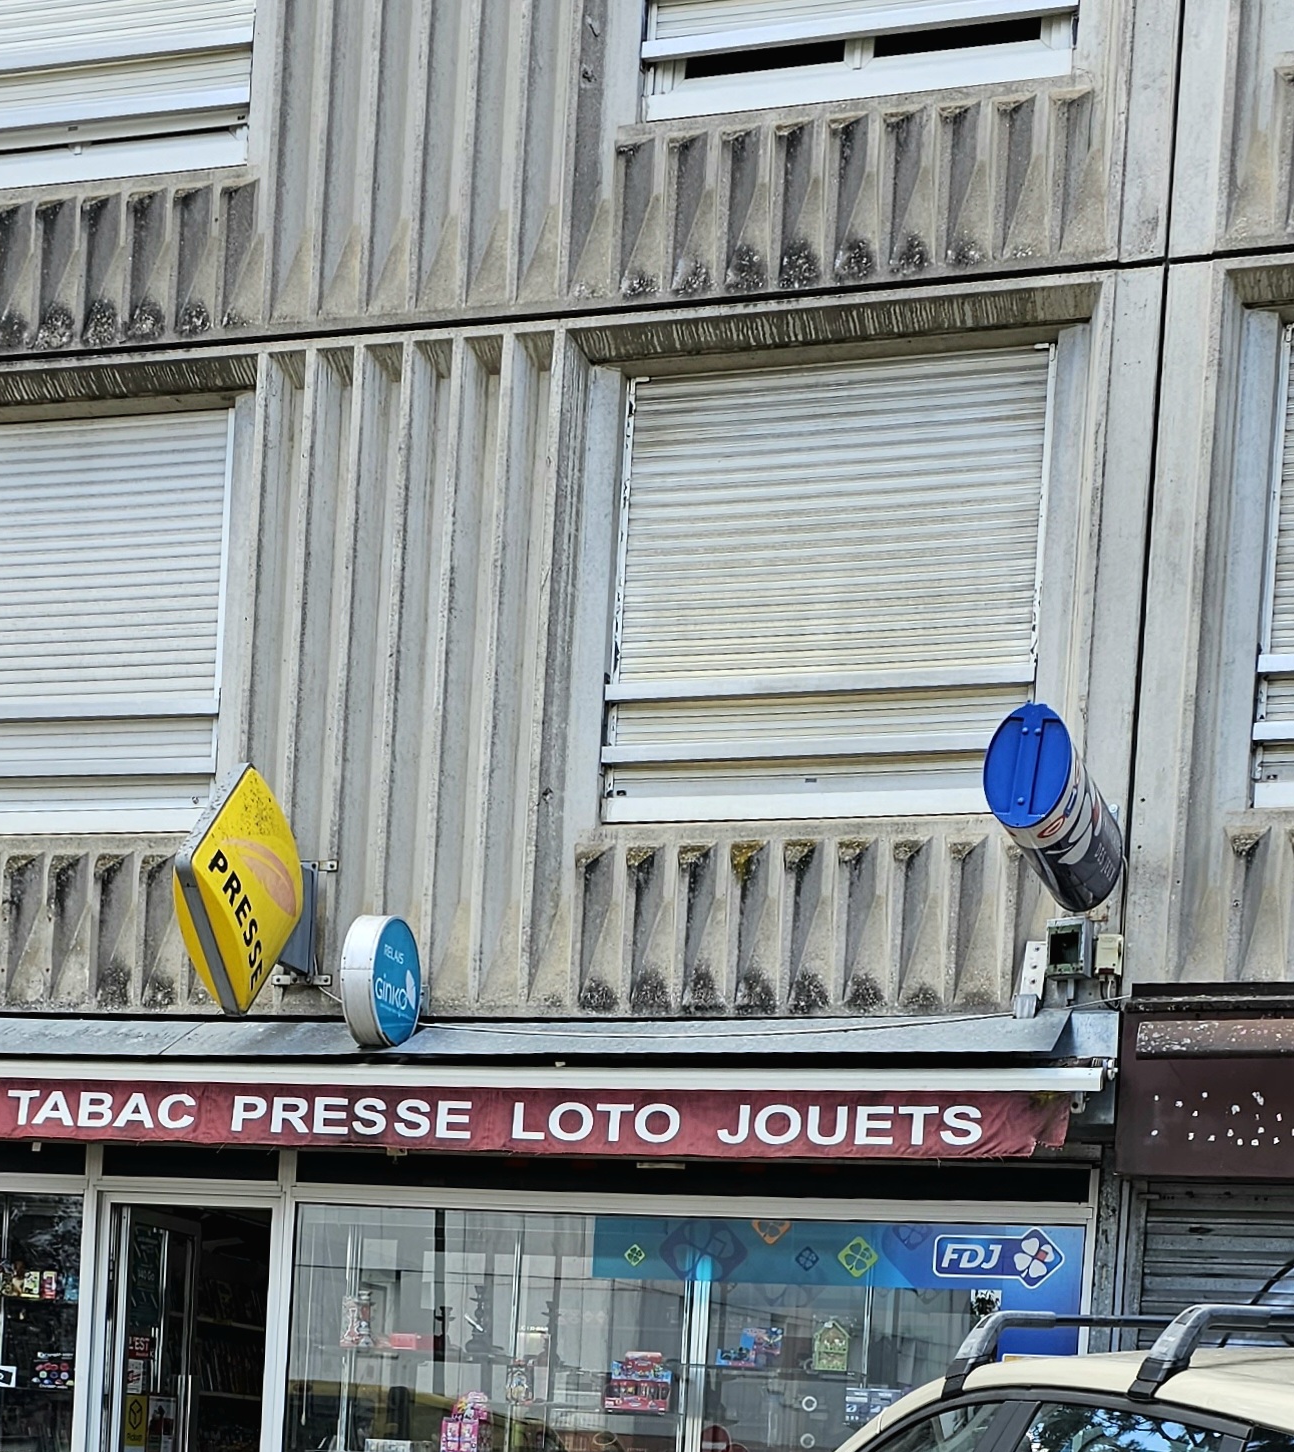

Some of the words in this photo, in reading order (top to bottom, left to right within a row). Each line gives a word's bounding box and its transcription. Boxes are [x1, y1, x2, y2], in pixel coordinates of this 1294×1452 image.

[207, 848, 265, 992] PRESSE
[383, 943, 405, 965] RELAIS
[7, 1088, 196, 1130] TABAC
[230, 1094, 473, 1140] PRESSE
[510, 1100, 681, 1144] LOTO
[716, 1103, 984, 1146] JOUETS
[940, 1243, 1003, 1270] FDJ
